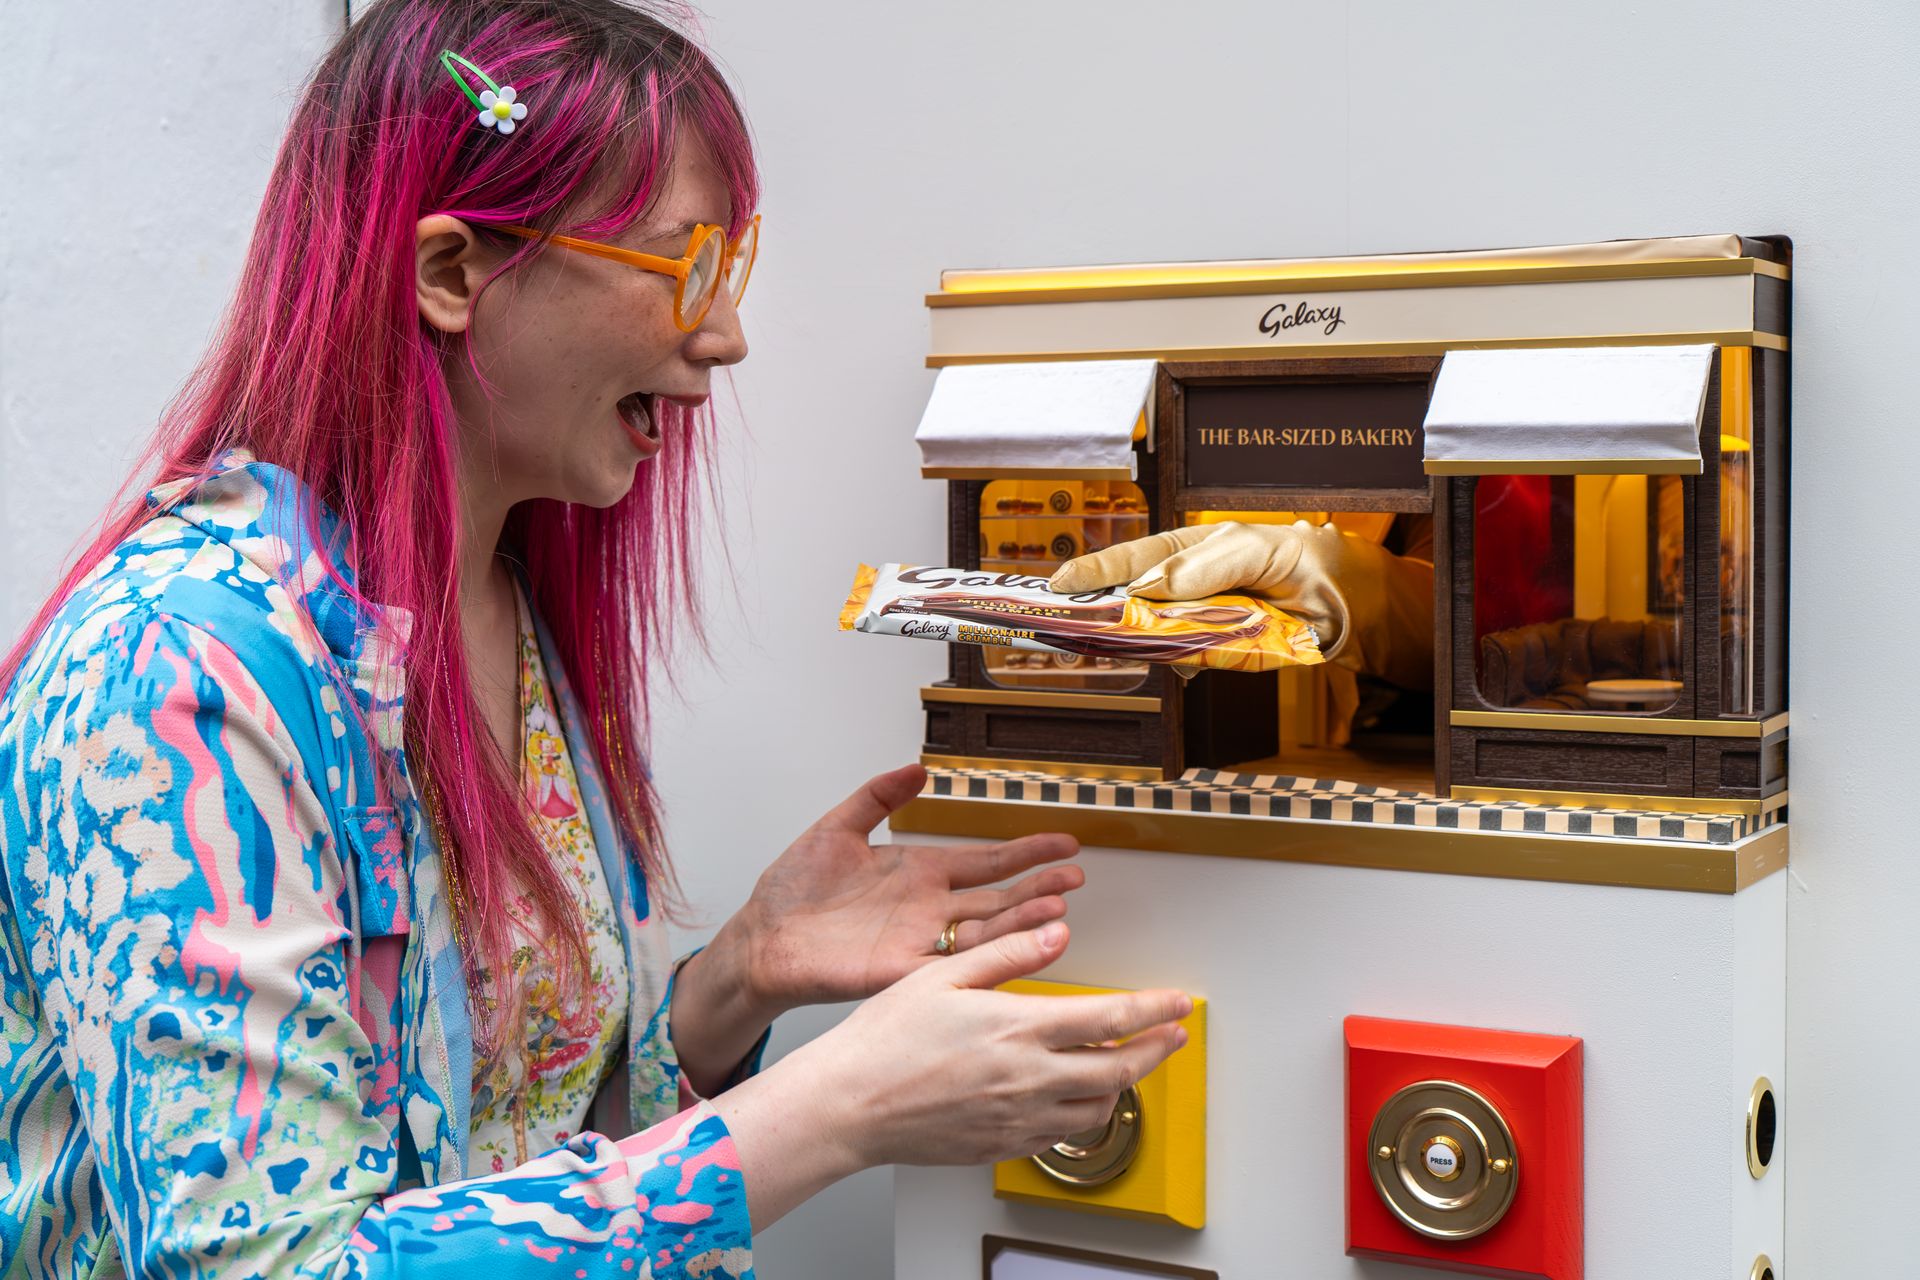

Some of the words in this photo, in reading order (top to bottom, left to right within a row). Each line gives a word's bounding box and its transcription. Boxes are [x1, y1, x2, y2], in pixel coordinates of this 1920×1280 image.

[1258, 301, 1346, 338] Galaxy
[1198, 428, 1233, 446] THE
[1237, 428, 1337, 446] BAR-SIZED
[1341, 428, 1417, 446] BAKERY
[957, 599, 1072, 615] MILLIONAIRE
[900, 619, 951, 640] Galaxy
[957, 623, 1036, 640] MILLIONAIRE
[956, 633, 1013, 647] CRUMBLE
[1430, 1156, 1453, 1166] PRESS
